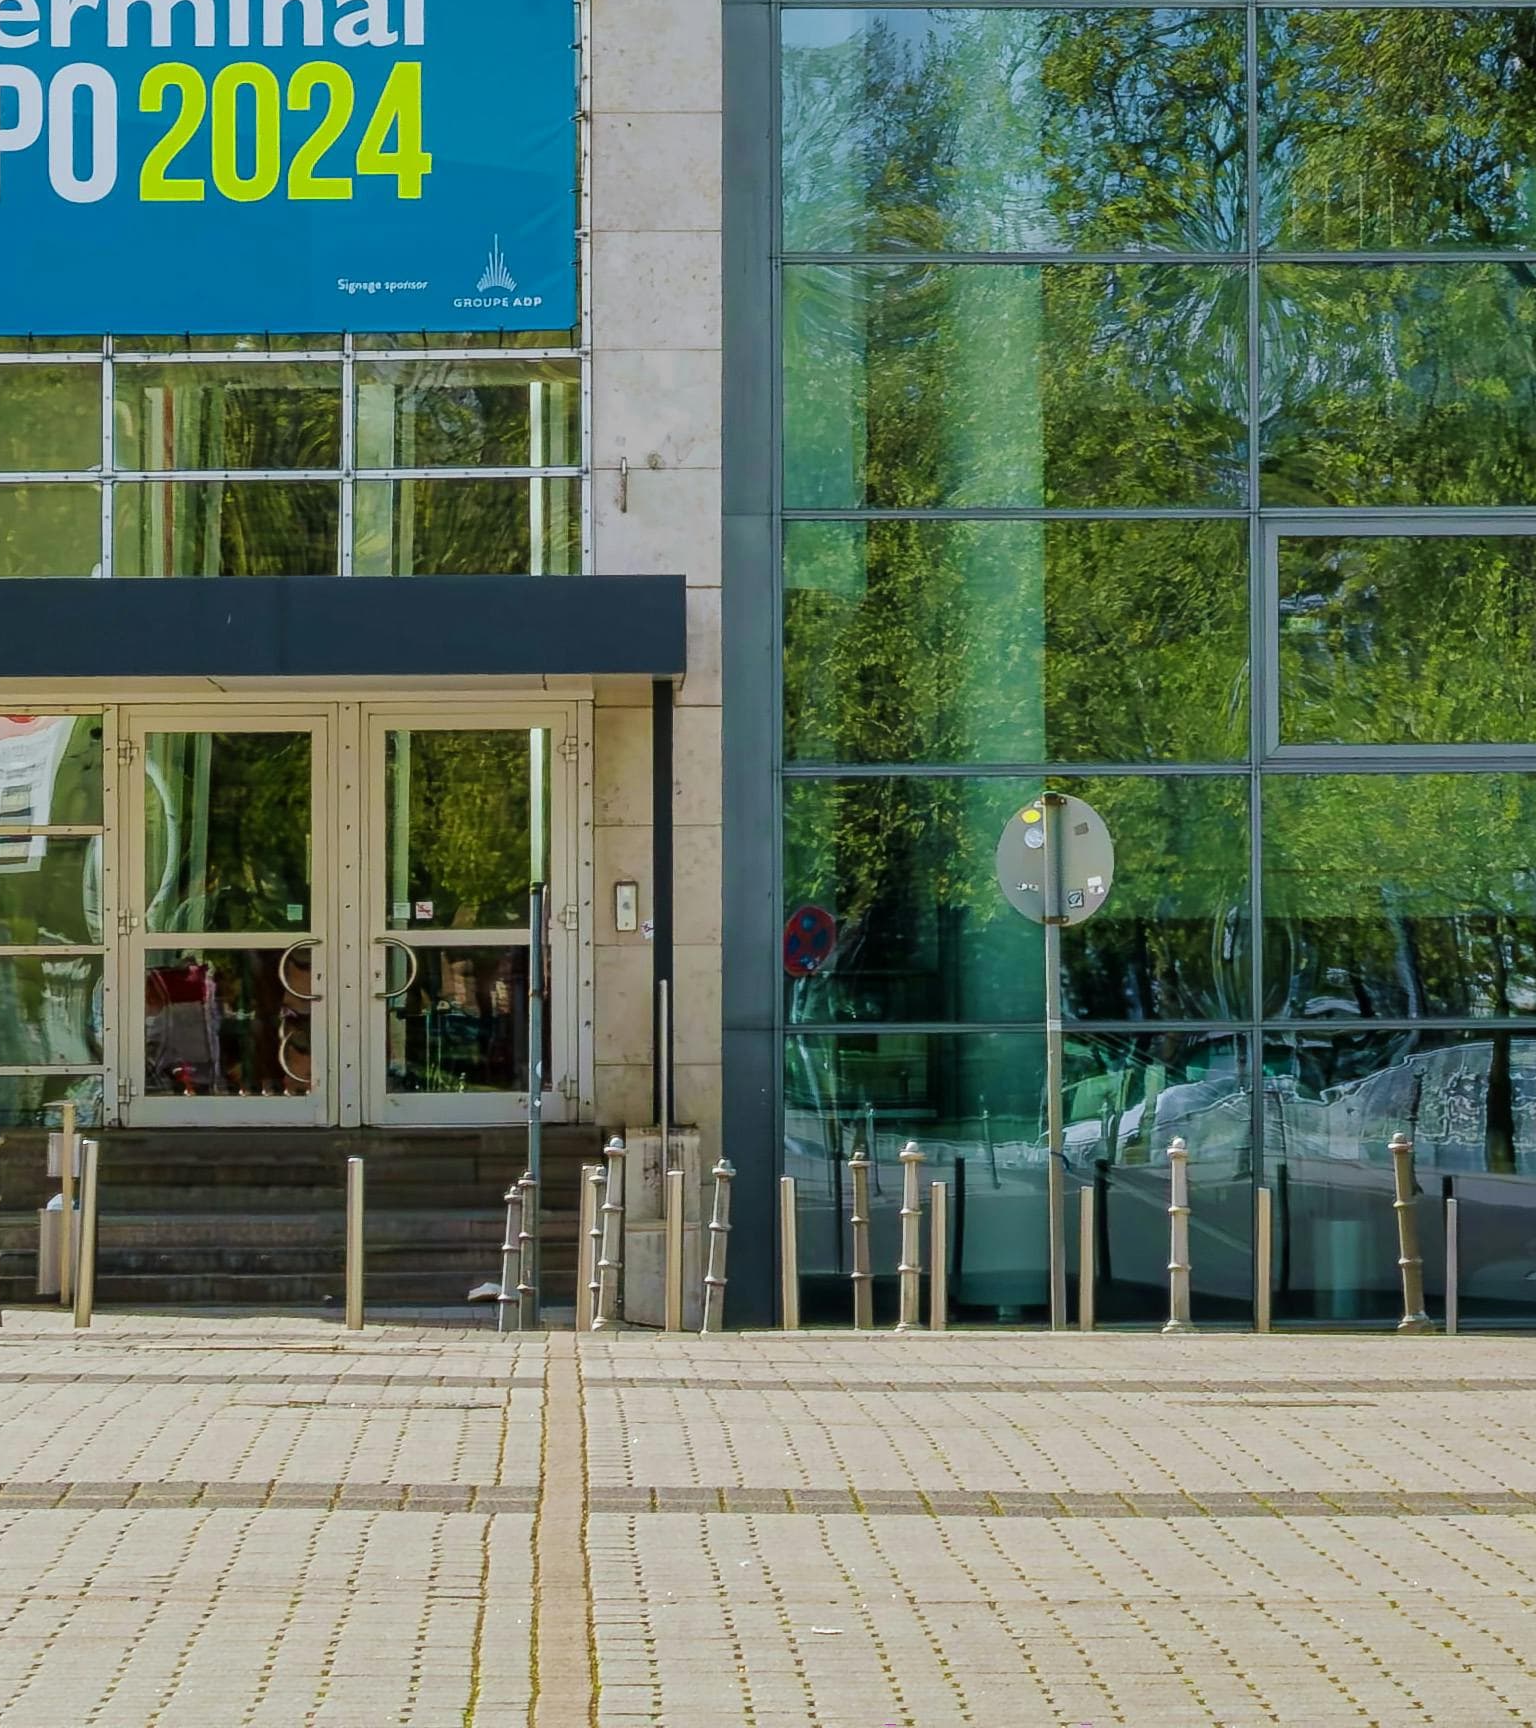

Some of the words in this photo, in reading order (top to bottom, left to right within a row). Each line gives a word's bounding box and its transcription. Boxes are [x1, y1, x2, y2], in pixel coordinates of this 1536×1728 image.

[138, 61, 433, 202] 2024
[337, 278, 382, 295] Signage
[384, 279, 429, 294] sponsor
[453, 297, 509, 309] GROUPE
[512, 296, 543, 308] ADP
